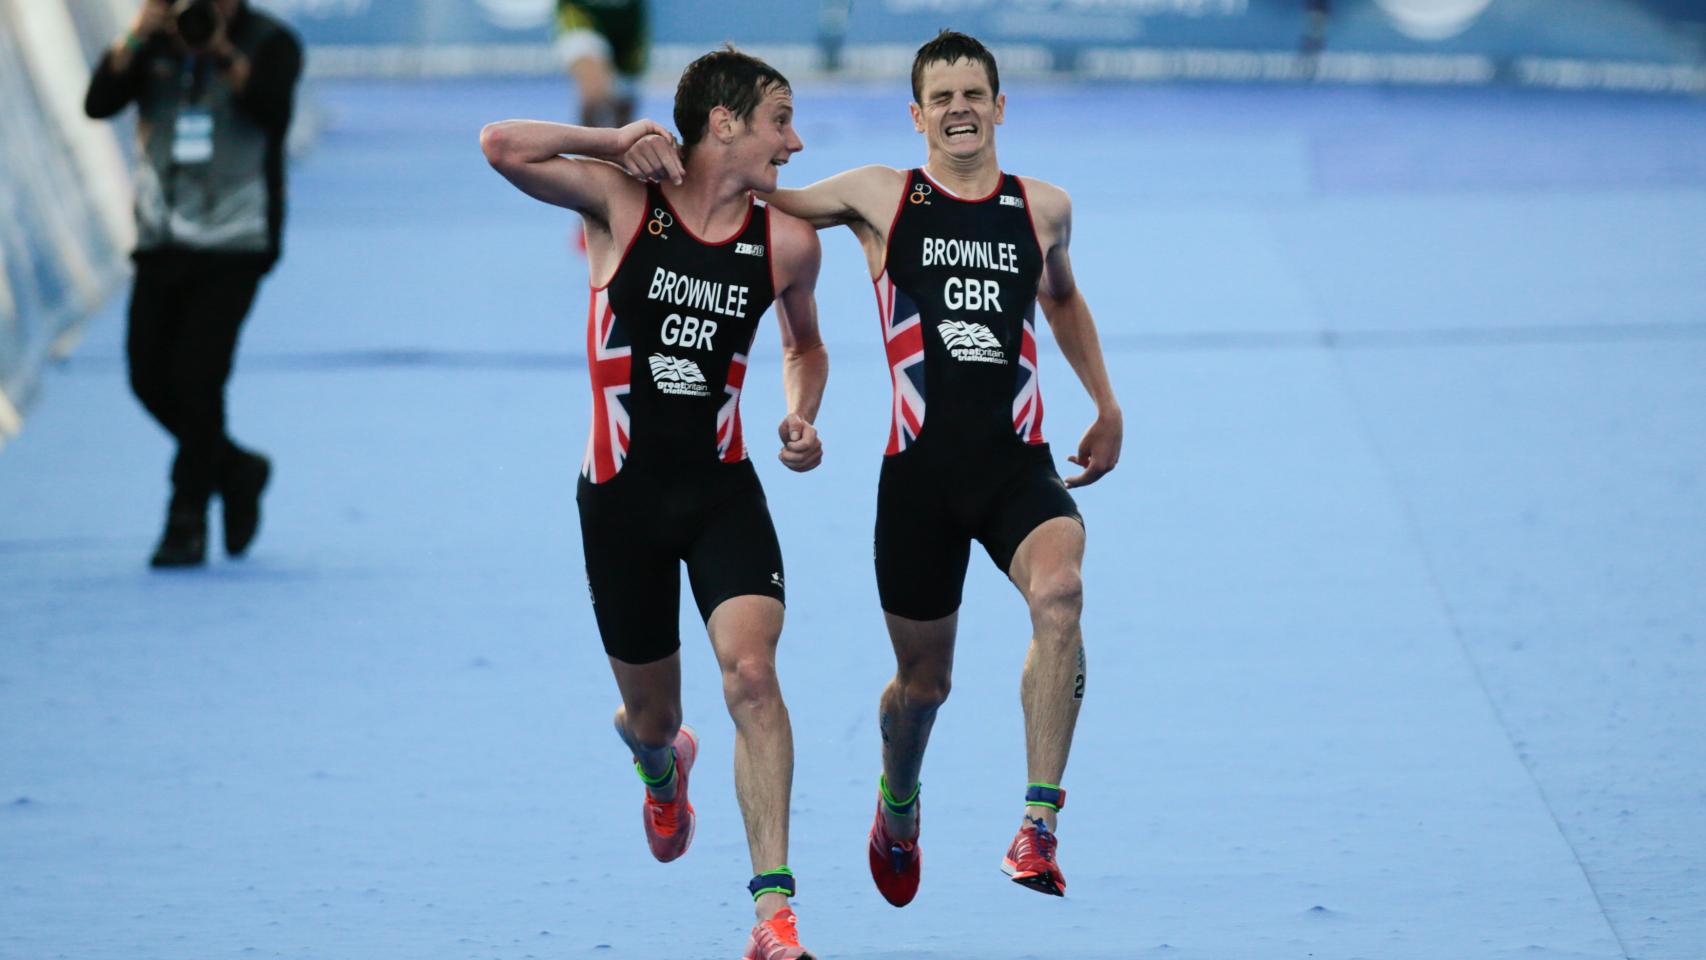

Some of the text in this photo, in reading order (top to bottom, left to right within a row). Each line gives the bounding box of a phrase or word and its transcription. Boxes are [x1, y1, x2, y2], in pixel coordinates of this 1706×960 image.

[922, 237, 1019, 274] BROWNLEE
[647, 267, 749, 318] BROWNLEE
[944, 277, 1003, 312] GBR
[661, 313, 718, 351] GBR
[1074, 674, 1085, 699] 2
